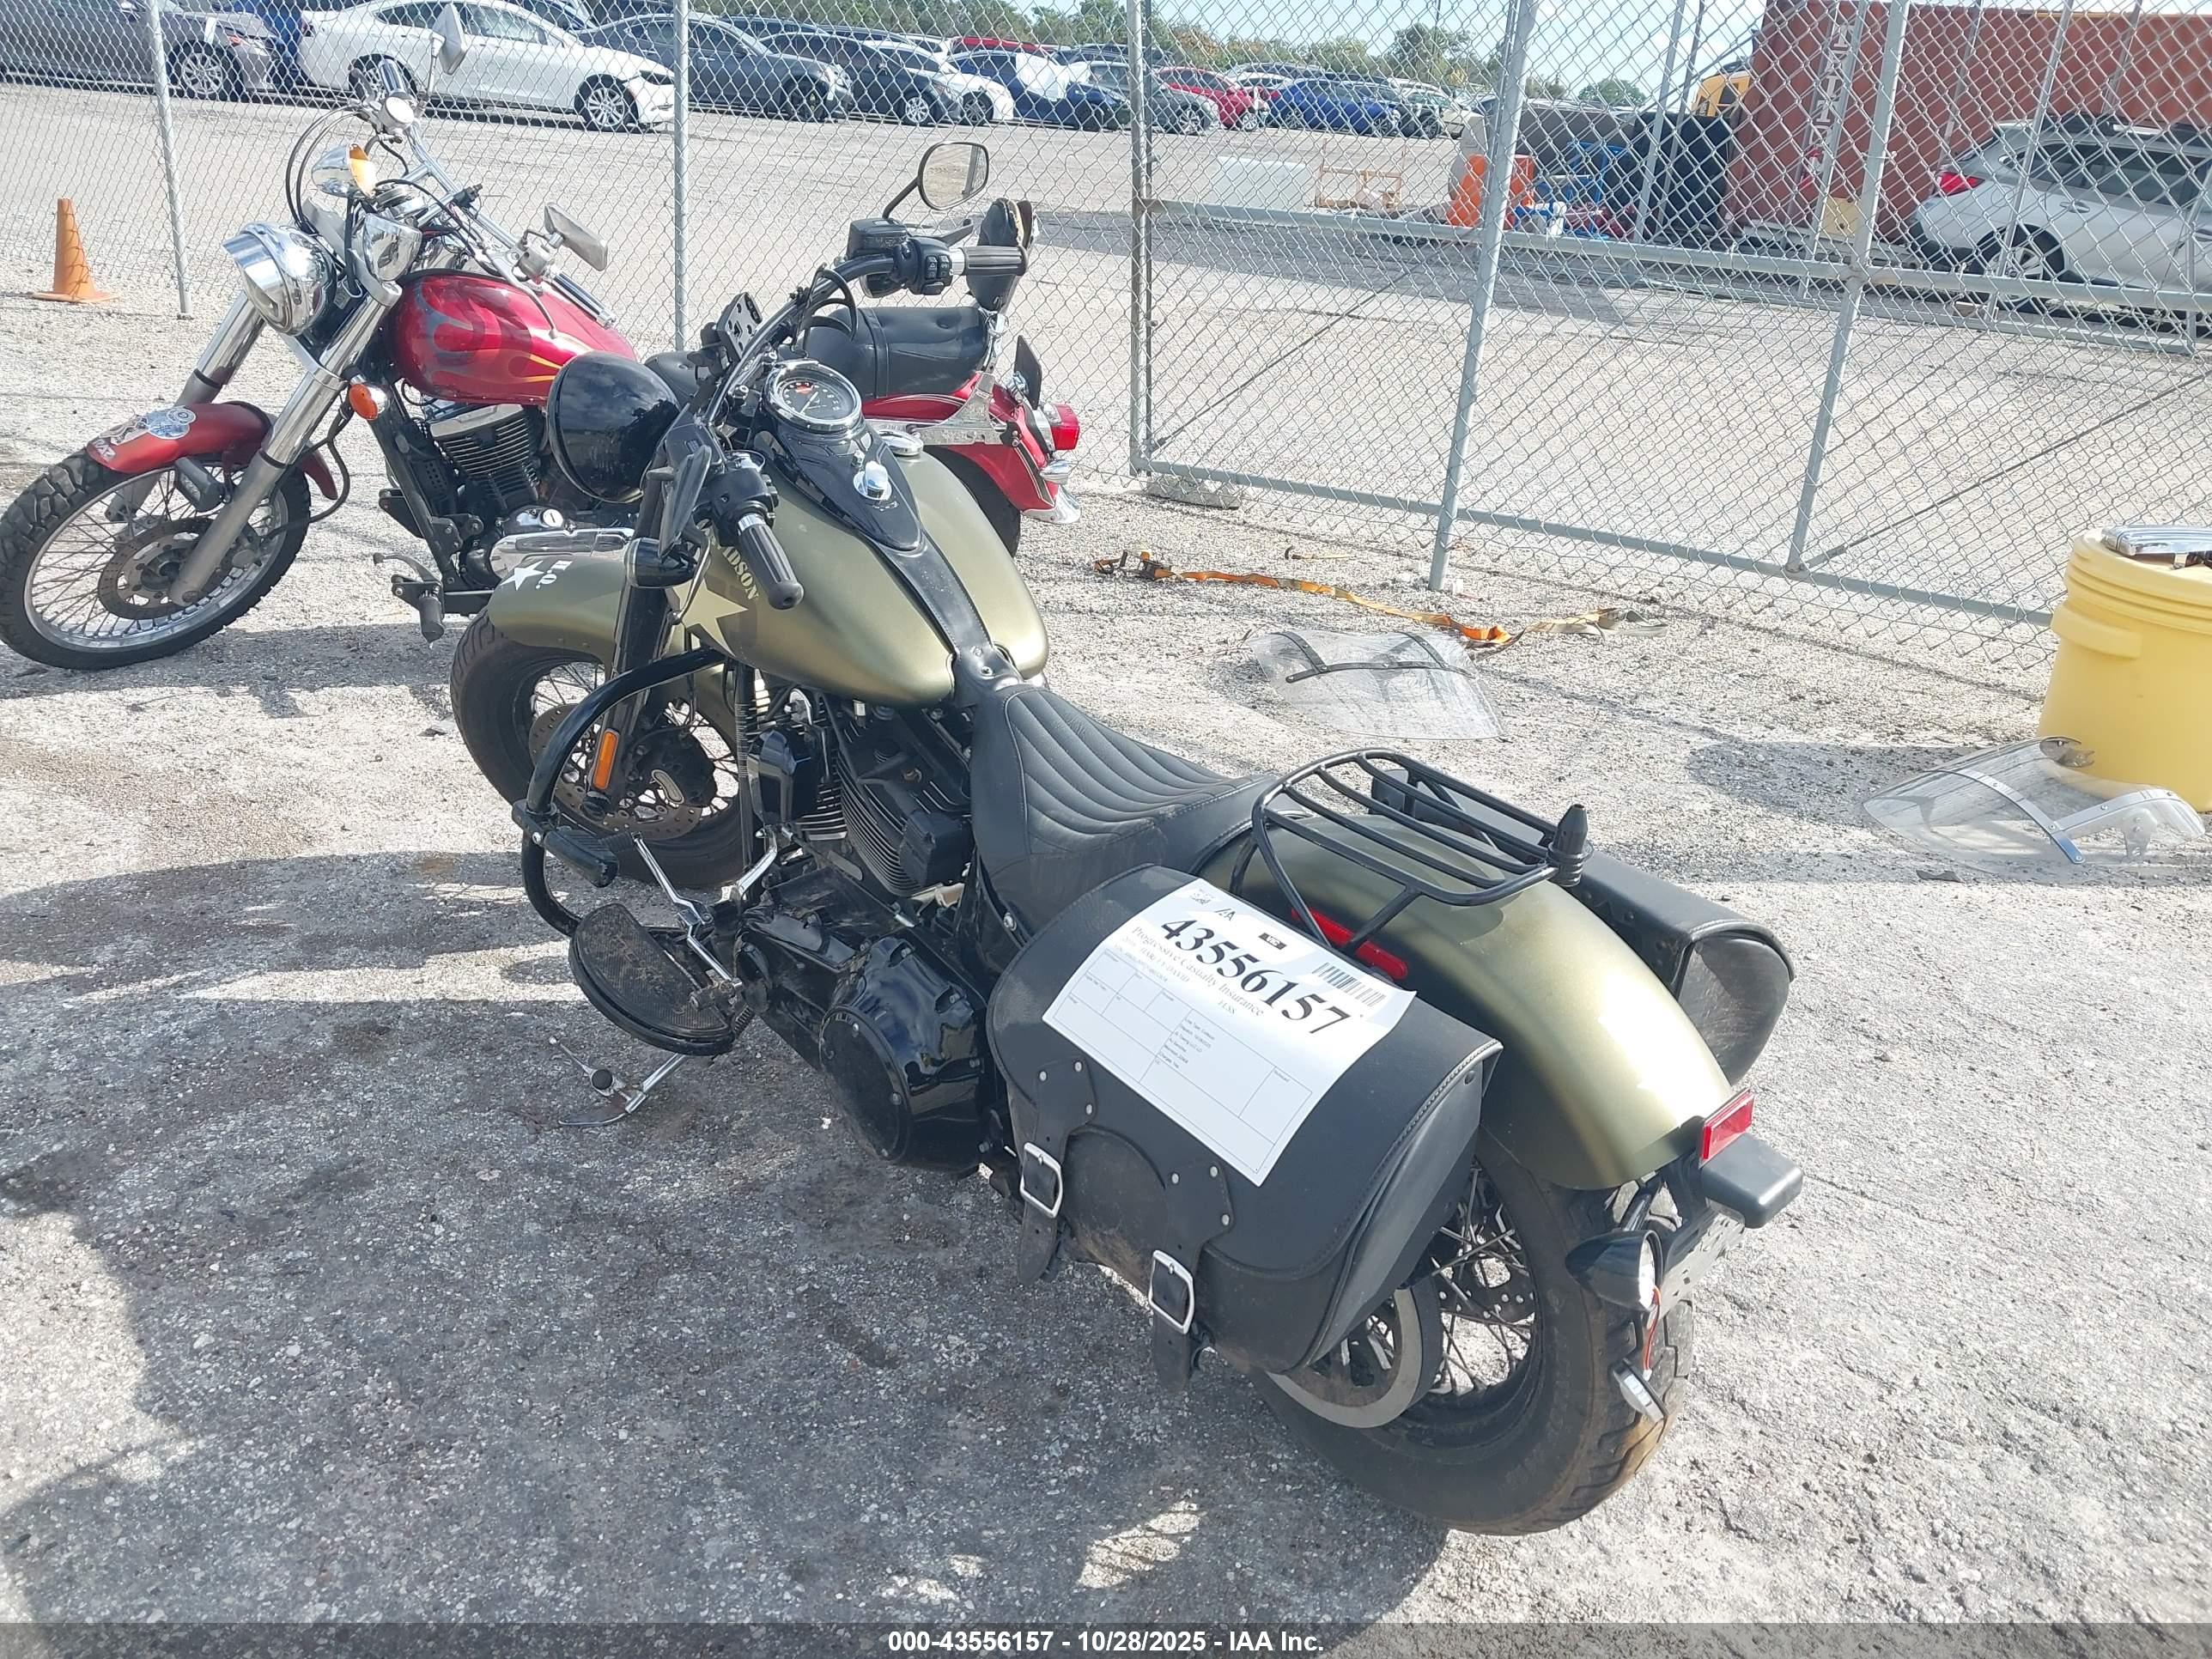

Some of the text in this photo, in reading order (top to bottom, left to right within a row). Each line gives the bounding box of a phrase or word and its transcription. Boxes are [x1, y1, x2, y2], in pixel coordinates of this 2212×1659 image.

[1132, 927, 1182, 962] Progressive
[1181, 956, 1218, 987] Casualty
[1218, 983, 1264, 1017] Insurance
[1161, 920, 1351, 1034] 43556157
